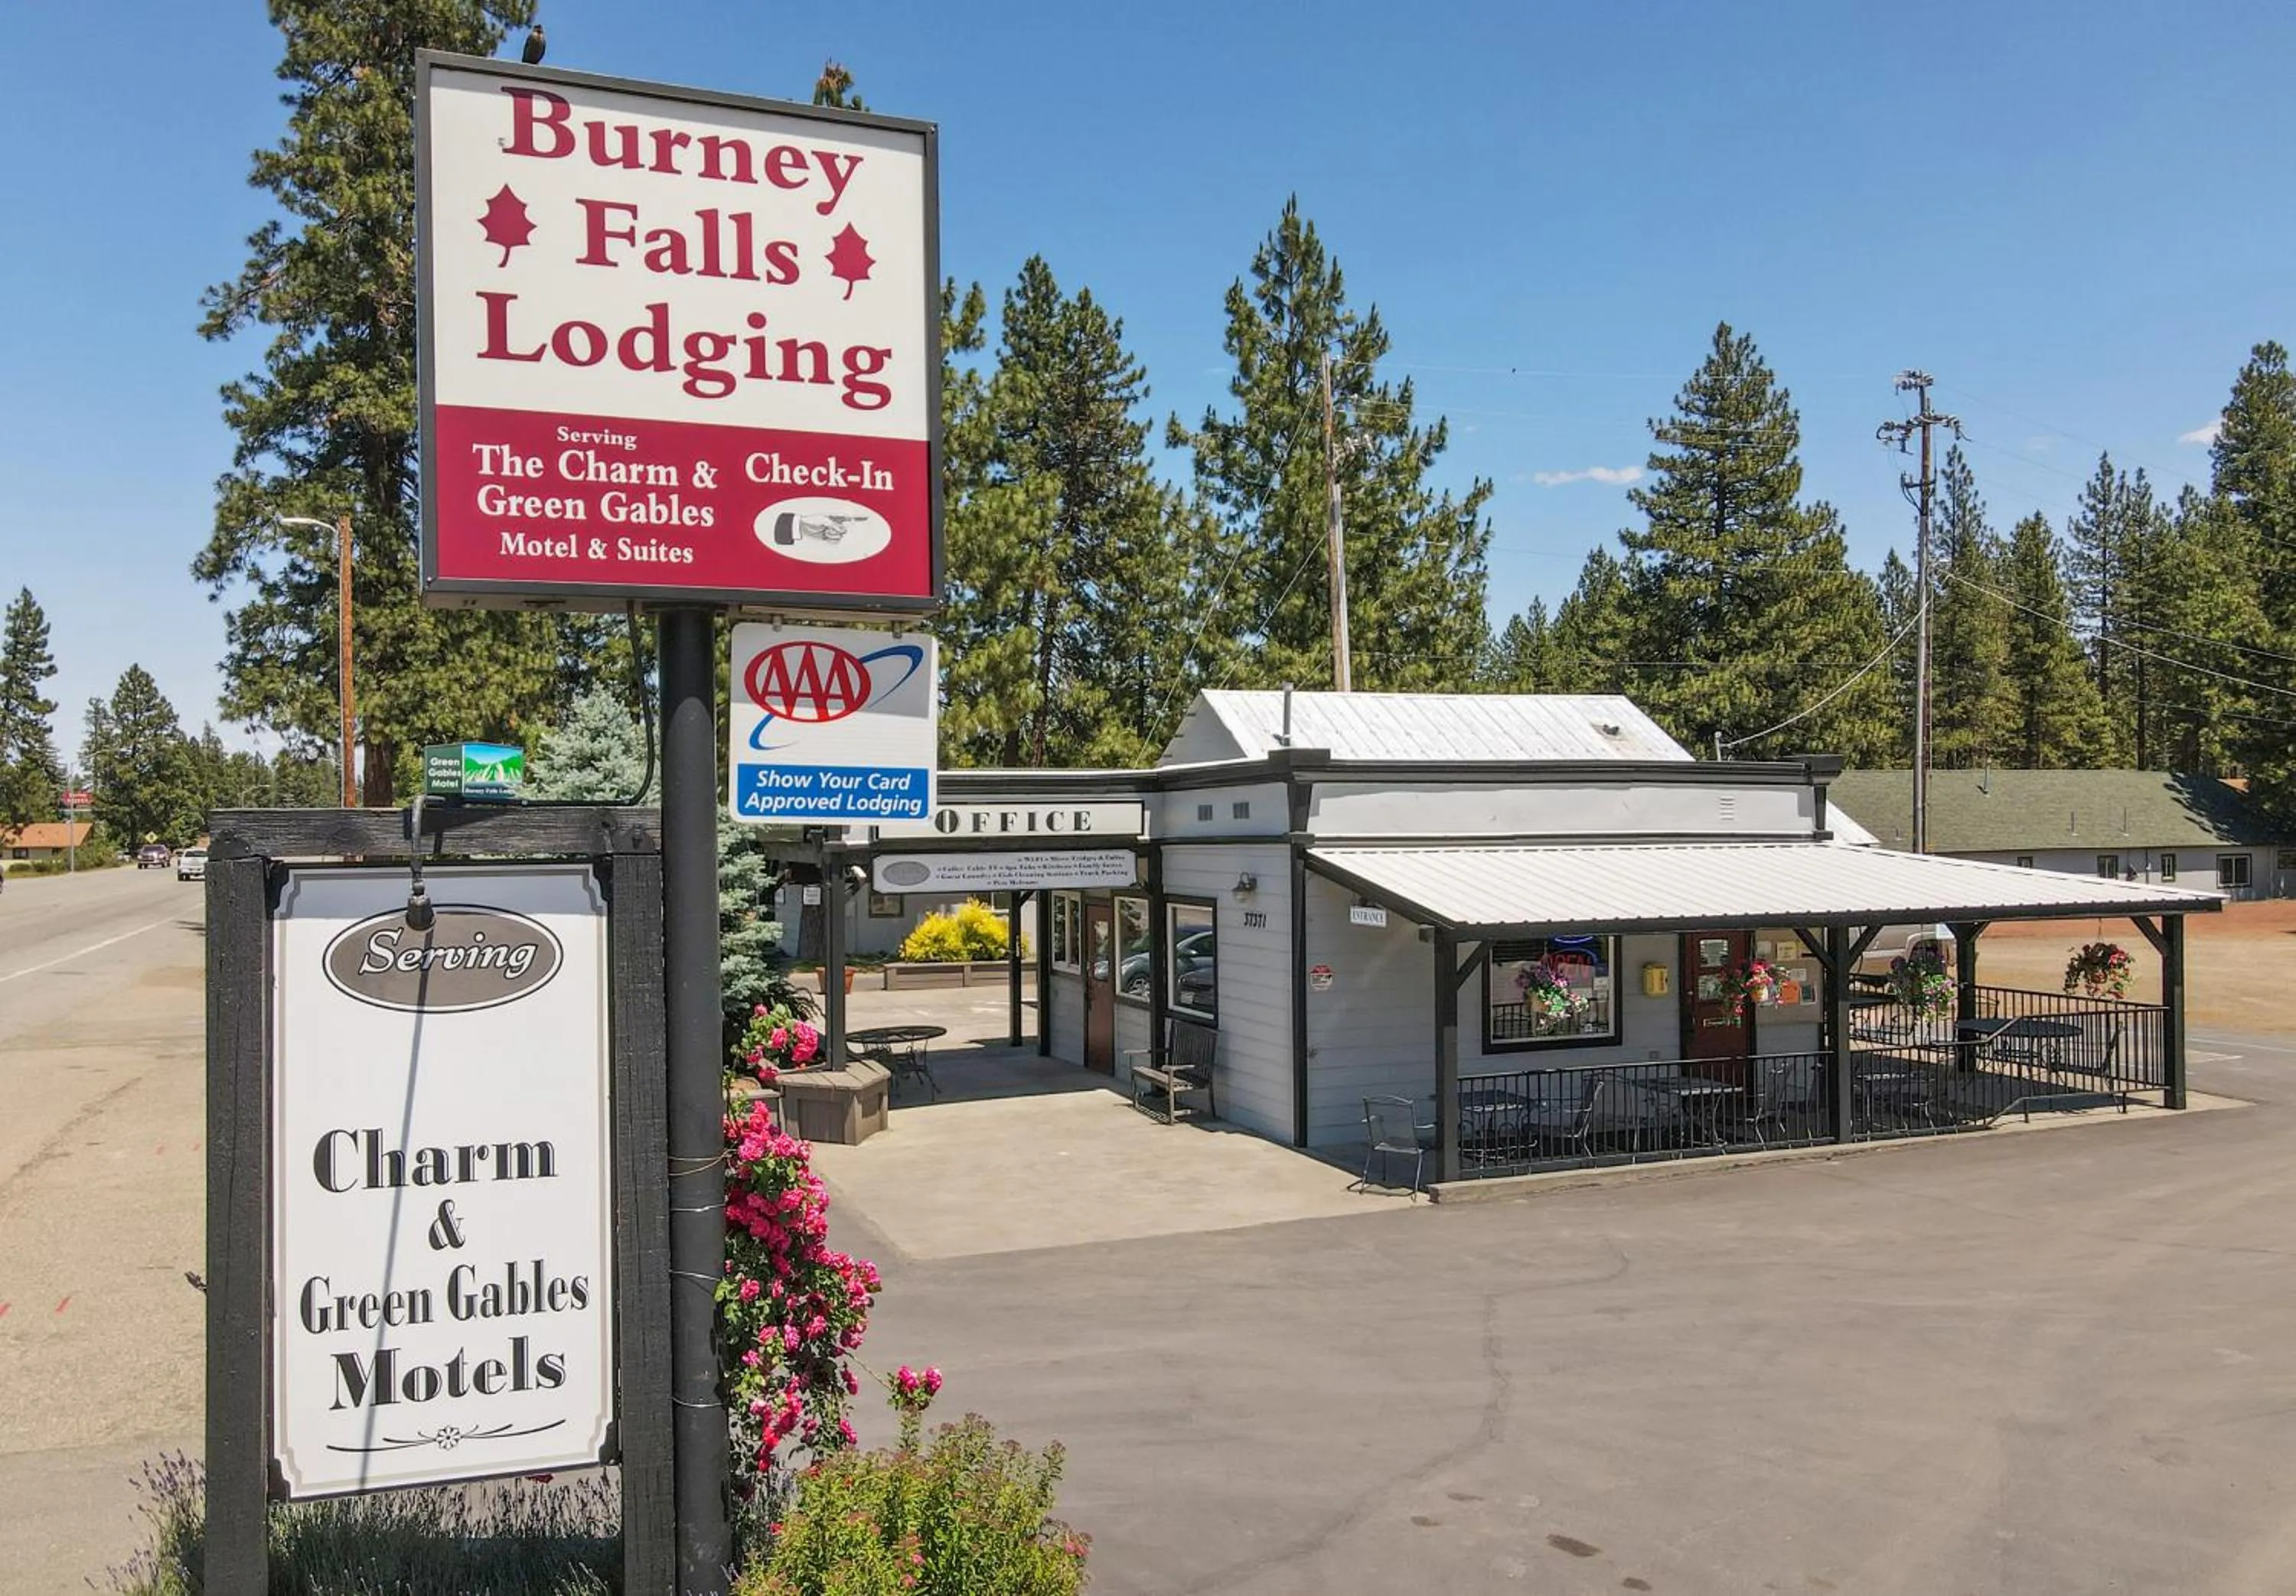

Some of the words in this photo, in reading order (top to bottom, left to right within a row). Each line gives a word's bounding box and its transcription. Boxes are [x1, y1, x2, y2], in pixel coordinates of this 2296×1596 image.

[501, 86, 864, 216] Burney
[576, 197, 800, 285] Falls
[475, 291, 892, 411] Lodging
[557, 426, 637, 451] Serving
[473, 443, 543, 478] The
[558, 447, 679, 486] Charm
[693, 461, 718, 489] &
[745, 452, 894, 491] Check-In
[477, 484, 586, 520] Green
[601, 490, 715, 528] Gables
[500, 533, 578, 559] Motel
[587, 538, 608, 559] &
[617, 537, 694, 564] Suites
[758, 644, 859, 719] AAA
[428, 767, 461, 777] Gables
[429, 757, 461, 767] Green
[431, 779, 459, 788] Motel
[756, 770, 813, 788] Show
[819, 771, 863, 790] Your
[867, 773, 912, 790] Card
[745, 793, 843, 816] Approved
[846, 793, 923, 816] Lodging
[934, 809, 1092, 834] OFFICE
[1352, 910, 1384, 923] ENTRANCE
[358, 927, 539, 980] Serving
[313, 1129, 557, 1194] Charm
[428, 1199, 466, 1252] &
[300, 1275, 434, 1334] Green
[448, 1259, 589, 1322] Gables
[329, 1334, 566, 1412] Motels
